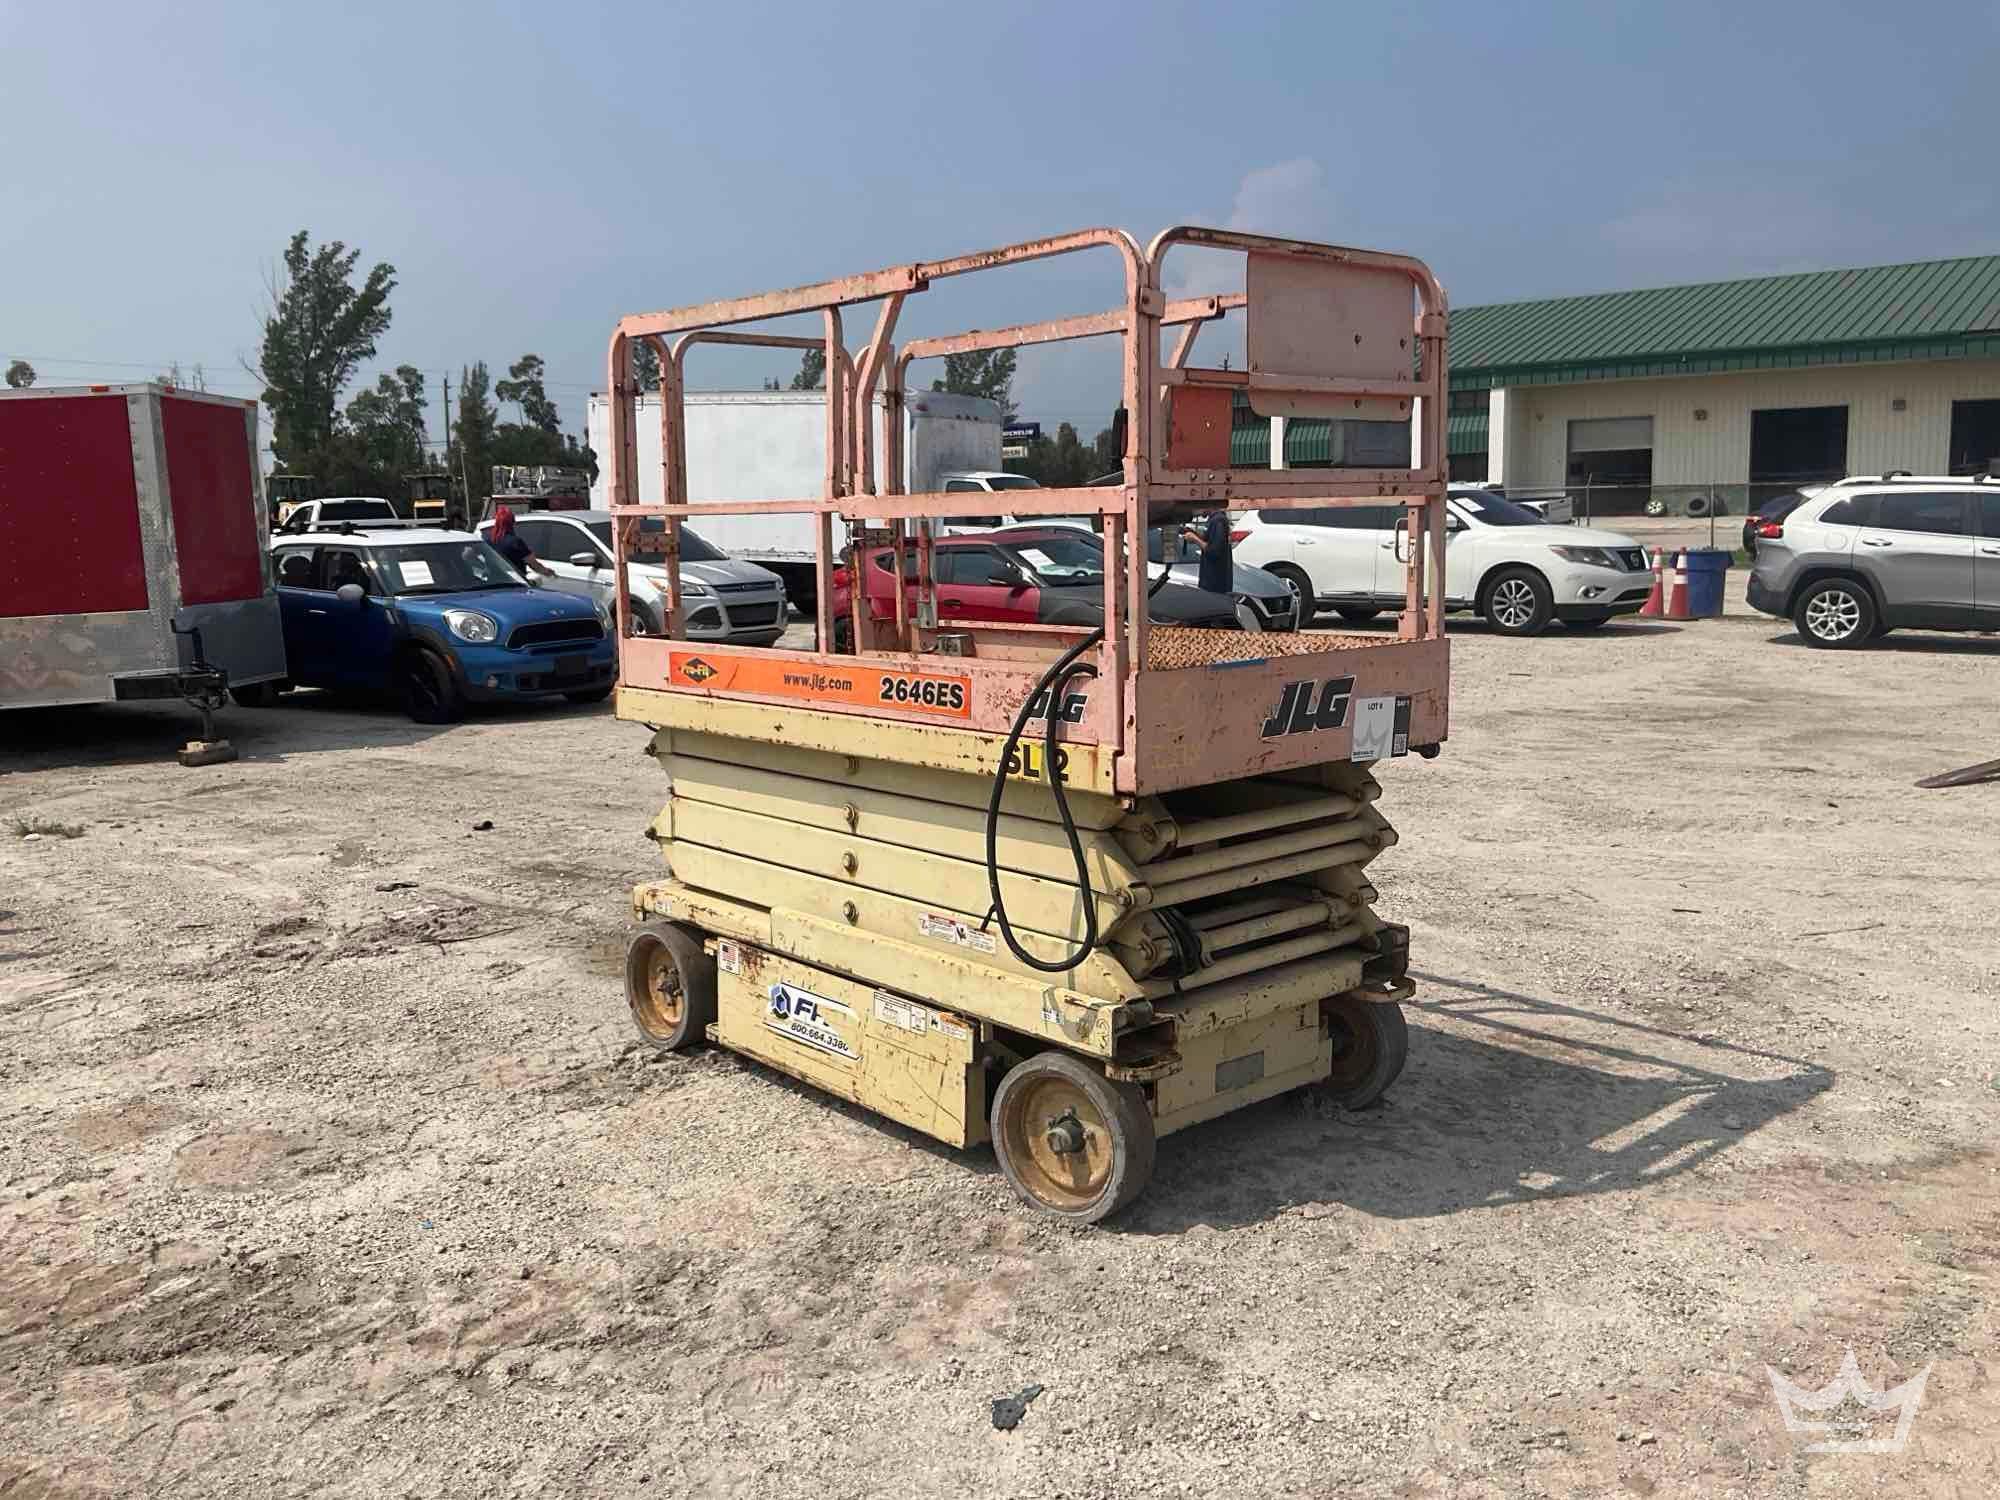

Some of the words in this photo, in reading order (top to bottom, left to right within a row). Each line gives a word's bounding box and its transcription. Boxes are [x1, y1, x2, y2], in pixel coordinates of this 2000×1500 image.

[783, 672, 853, 692] www.jlg.com
[880, 676, 964, 710] 2646ES
[1261, 674, 1357, 739] JLG
